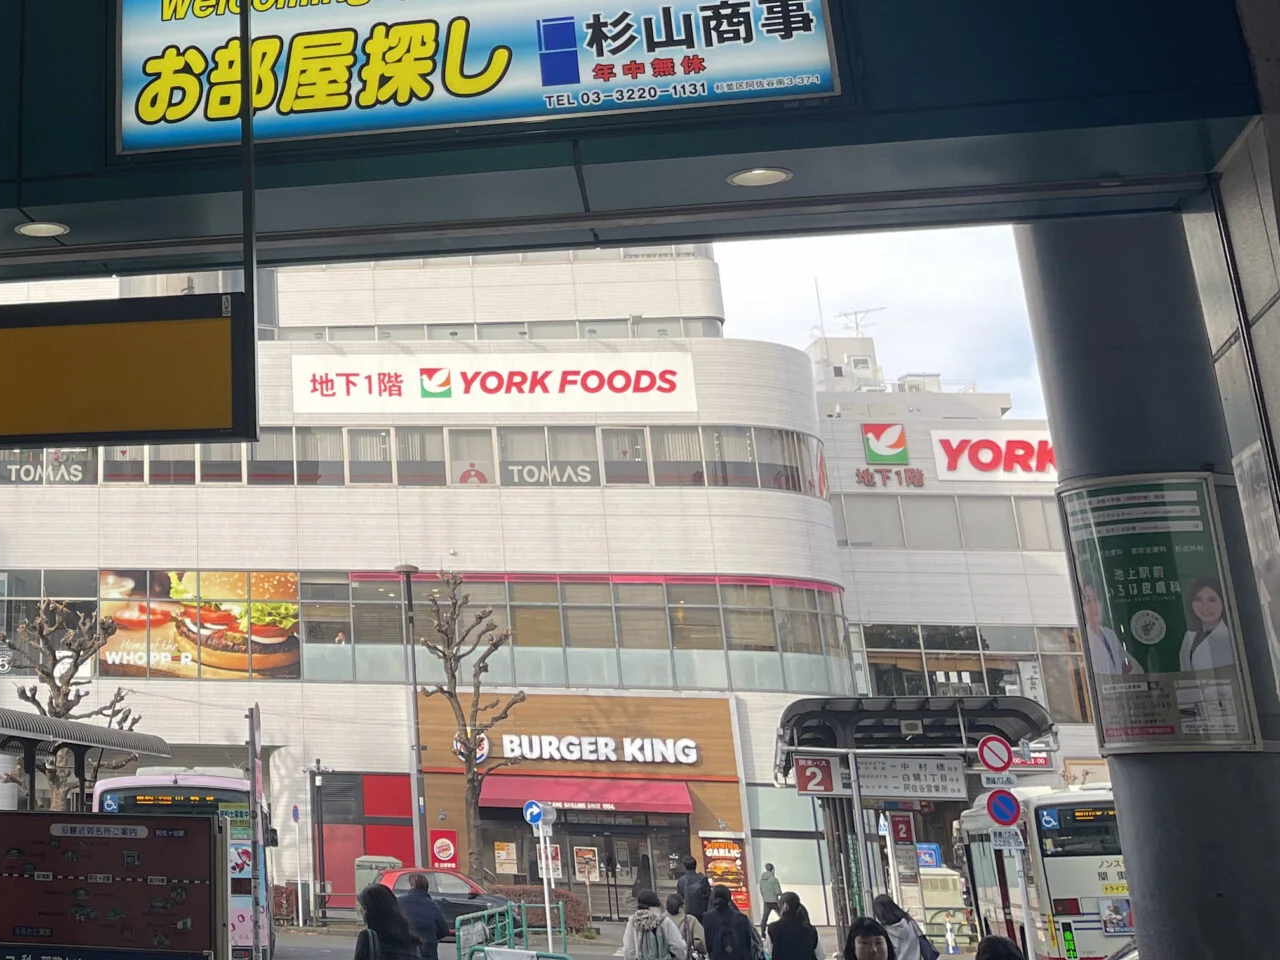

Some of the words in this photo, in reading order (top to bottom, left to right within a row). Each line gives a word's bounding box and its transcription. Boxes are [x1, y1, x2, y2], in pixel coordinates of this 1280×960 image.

[135, 16, 513, 126] お部屋探し
[592, 55, 706, 82] 年中無休
[545, 95, 577, 108] TEL
[581, 82, 708, 105] 03-3220-1131
[310, 371, 404, 398] 地下1階
[460, 370, 554, 395] YORK
[558, 370, 677, 394] FOODS
[939, 439, 1058, 473] YORK
[8, 464, 83, 482] TOMAS
[508, 465, 592, 483] TOMAS
[856, 468, 925, 487] 地下1階
[1114, 566, 1165, 581] 池上駅前
[502, 734, 617, 762] BURGER
[623, 737, 698, 764] KING
[805, 767, 825, 790] 2
[898, 823, 907, 838] 2
[705, 848, 741, 857] GARLIC
